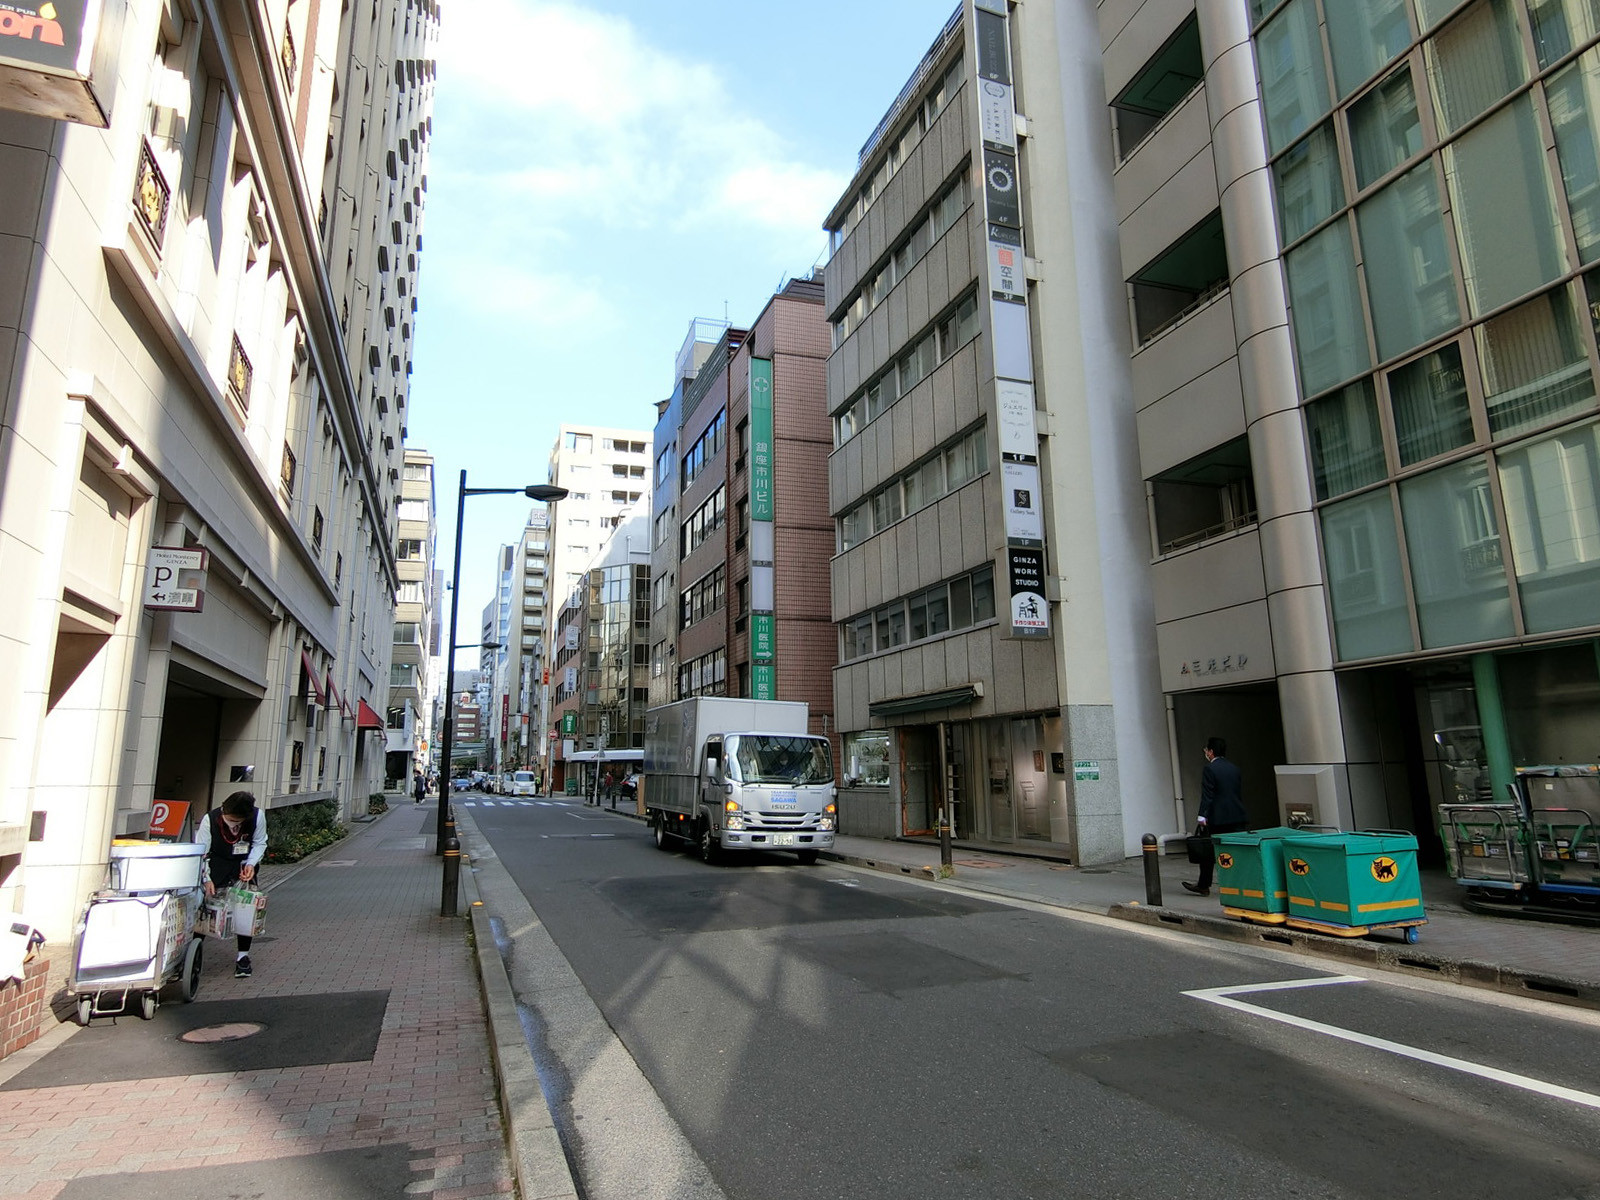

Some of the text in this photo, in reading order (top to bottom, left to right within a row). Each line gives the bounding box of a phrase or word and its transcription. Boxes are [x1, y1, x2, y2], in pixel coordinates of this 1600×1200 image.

[16, 7, 37, 16] PUB
[1013, 453, 1025, 461] 1F
[755, 441, 768, 514] 銀座市川ビル
[1013, 556, 1037, 565] GINZA
[1014, 567, 1038, 576] WORK
[152, 566, 173, 588] P
[1015, 579, 1039, 587] STUDIO
[758, 616, 769, 650] 市川医院
